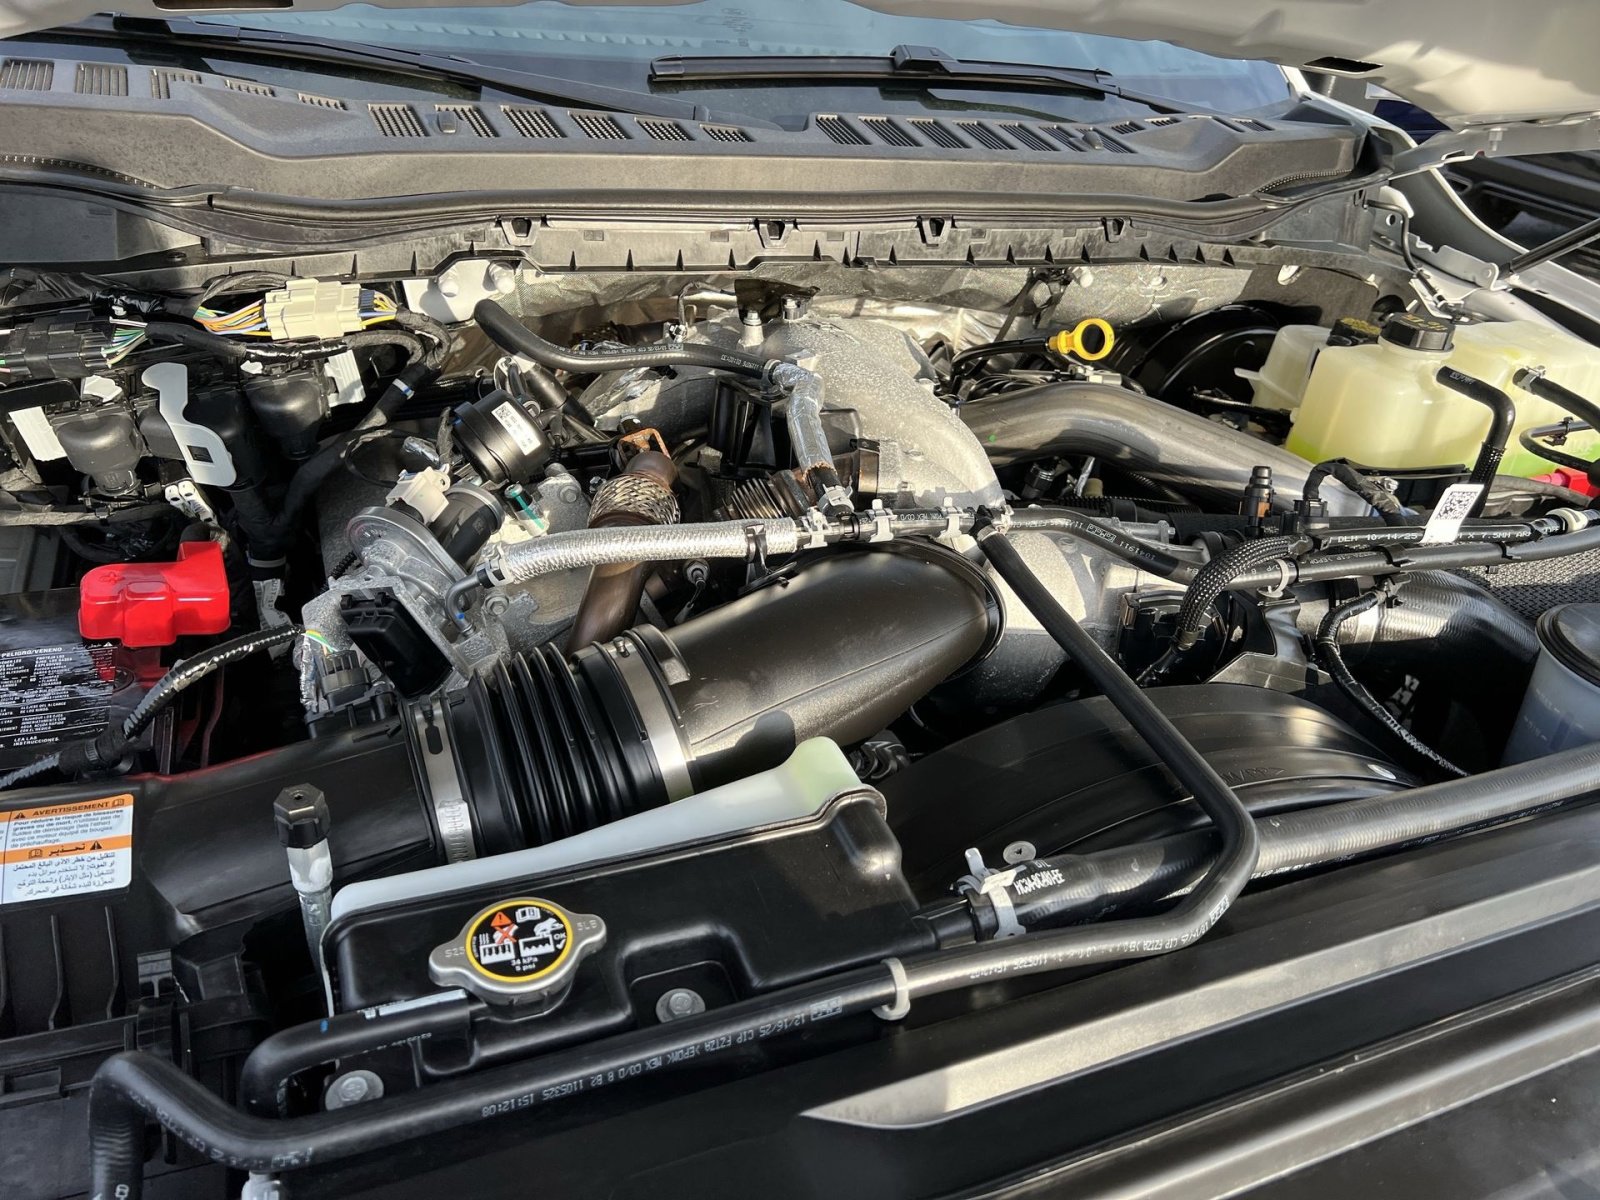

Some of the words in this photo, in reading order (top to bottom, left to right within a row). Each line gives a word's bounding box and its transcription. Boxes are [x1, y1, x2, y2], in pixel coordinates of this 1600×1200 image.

[1366, 532, 1418, 542] 10/14/25
[1, 647, 63, 658] PELIGRO/VENENO
[33, 801, 110, 817] AVERTISSEMENT
[553, 932, 567, 940] OK
[511, 958, 521, 967] 34
[522, 955, 539, 965] kPa
[522, 962, 536, 971] psi
[759, 1011, 807, 1038] 12/16/25
[736, 1028, 756, 1045] CIP
[645, 1055, 663, 1069] MEX
[480, 1093, 535, 1119] 15:12:08
